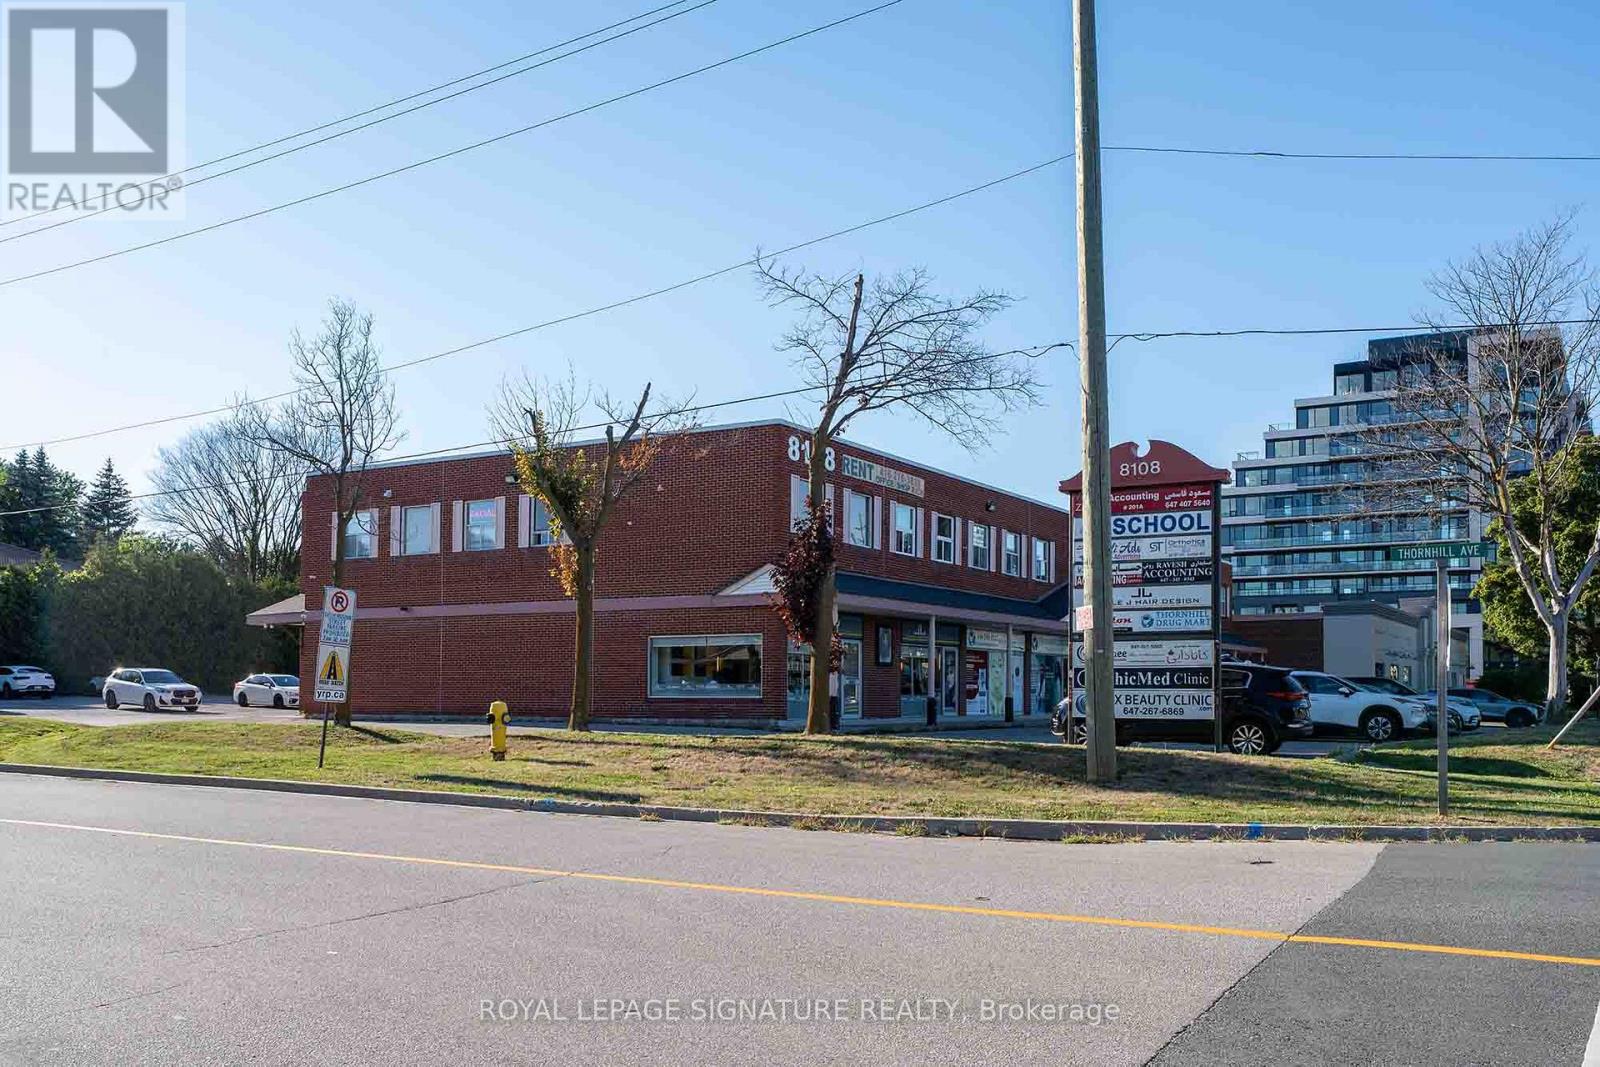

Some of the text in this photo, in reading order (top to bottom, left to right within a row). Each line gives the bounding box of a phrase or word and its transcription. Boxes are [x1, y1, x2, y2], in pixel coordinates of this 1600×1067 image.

[788, 435, 836, 471] 818
[843, 456, 875, 481] RENT
[1120, 461, 1161, 476] 8108
[1165, 500, 1178, 508] 647
[1113, 513, 1210, 535] SCHOOL
[1397, 545, 1480, 559] THORNHILL AVE
[1143, 567, 1212, 578] ACCOUNTING
[1112, 575, 1127, 585] ING
[1156, 611, 1209, 619] THORNHILL
[1156, 617, 1210, 627] DRUG MART
[1115, 672, 1209, 685] hicMed Clinic
[317, 690, 344, 699] yrp.ca
[1126, 695, 1171, 705] BEAUTY
[1173, 695, 1212, 705] CLINIC
[1123, 707, 1184, 716] 647-267-6869
